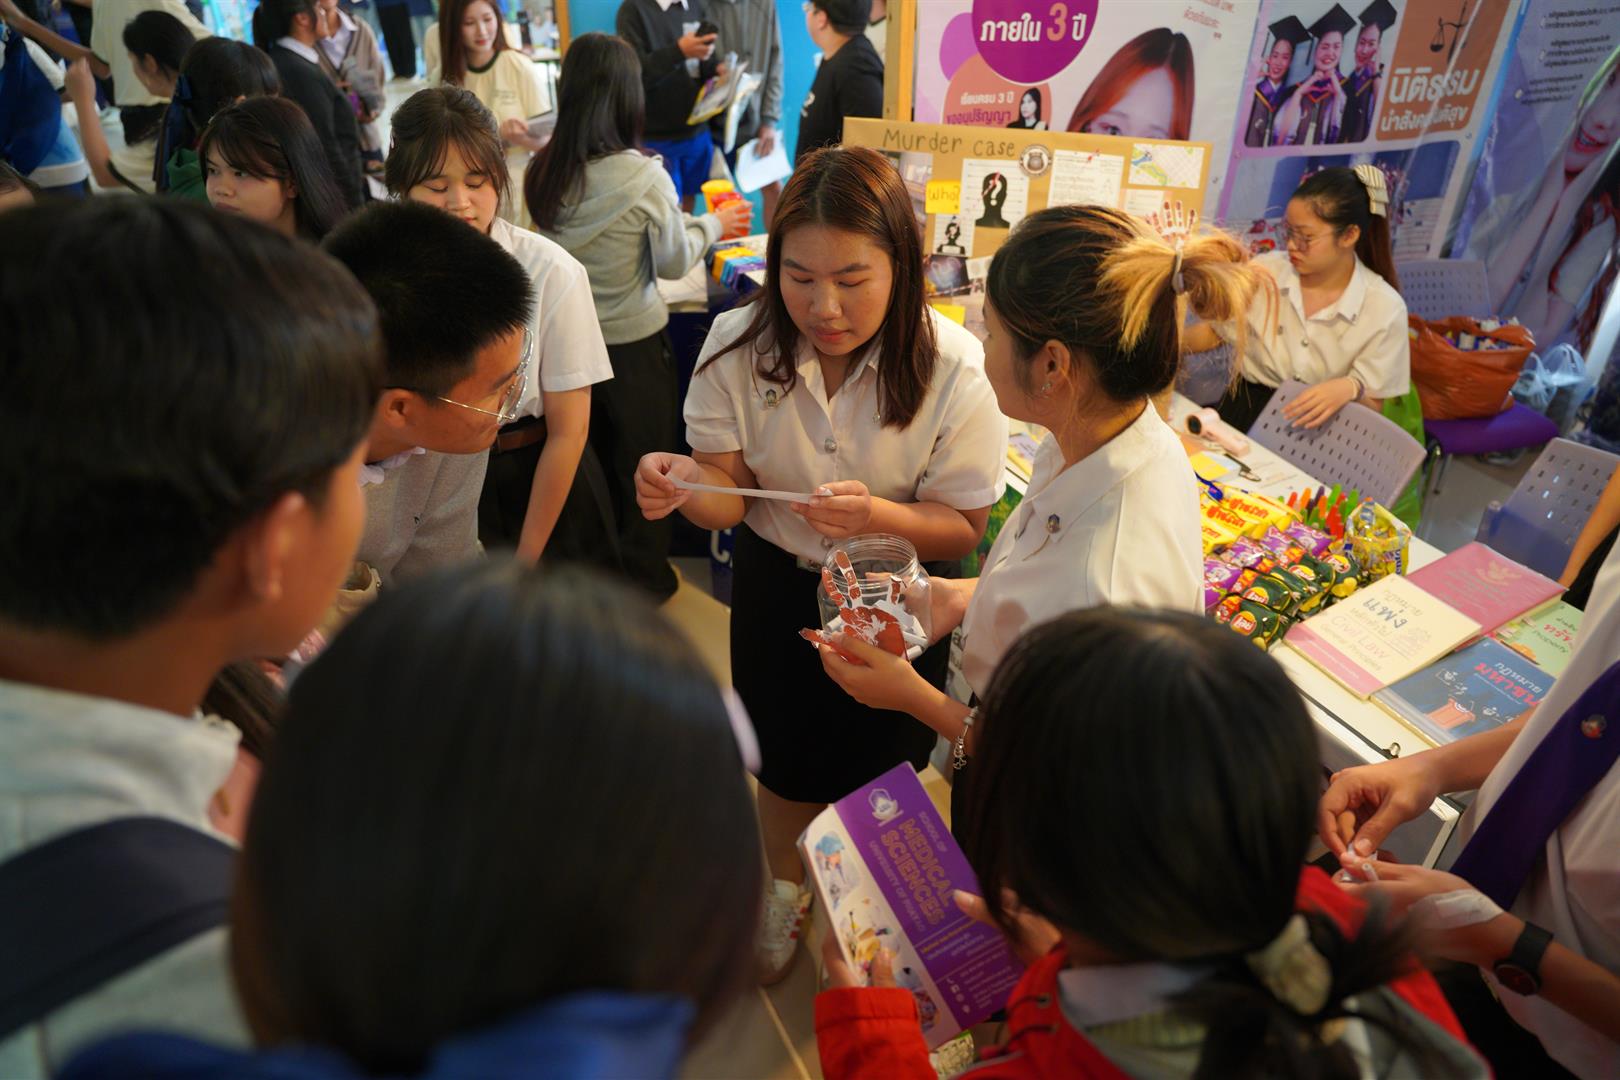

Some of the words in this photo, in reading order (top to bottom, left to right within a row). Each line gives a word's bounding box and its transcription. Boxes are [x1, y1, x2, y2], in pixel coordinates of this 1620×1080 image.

[980, 12, 1042, 42] ภายใน
[1047, 2, 1068, 42] 3
[1072, 12, 1087, 42] ปี
[997, 92, 1006, 103] 3
[1389, 66, 1480, 104] นิติธรม
[882, 128, 963, 155] Murder
[972, 138, 1016, 157] case
[1362, 597, 1408, 629] แพ่ง
[1495, 662, 1543, 694] กฎหมาย
[881, 829, 945, 924] SCIENCES
[899, 817, 956, 906] MEDICAL
